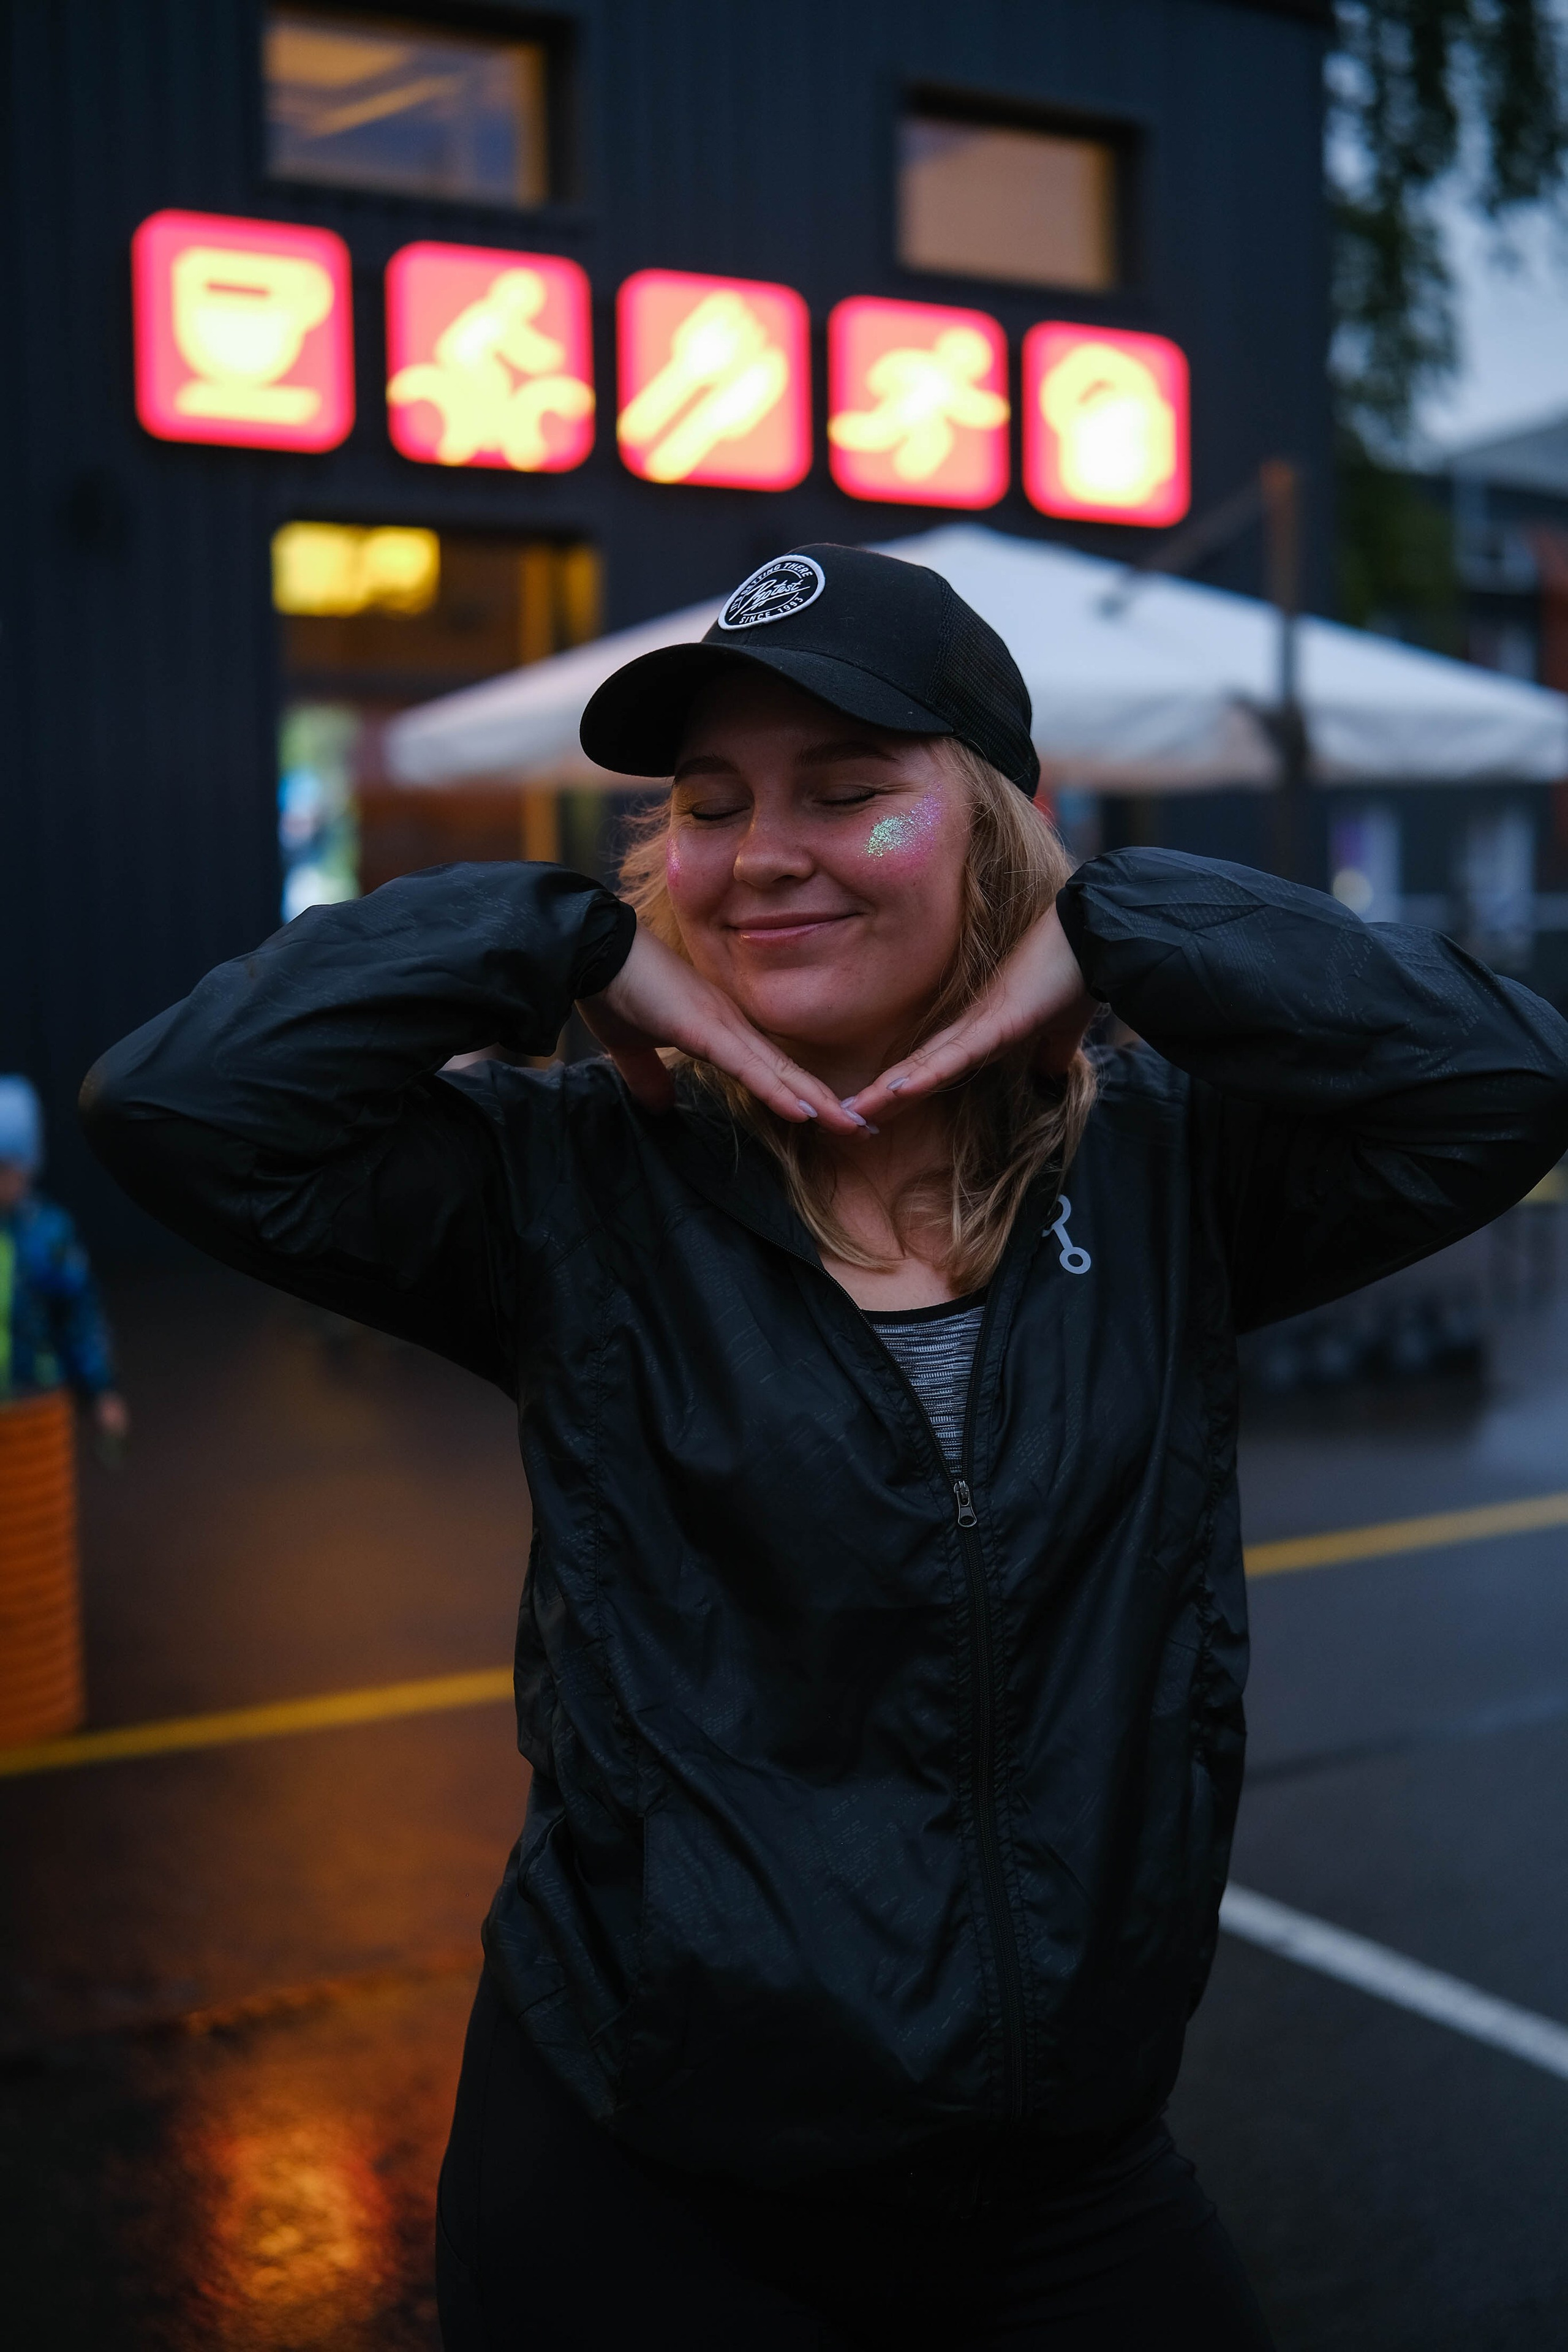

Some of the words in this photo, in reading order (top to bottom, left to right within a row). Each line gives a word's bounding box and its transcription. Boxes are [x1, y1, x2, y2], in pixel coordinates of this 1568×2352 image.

[741, 564, 781, 595] GETTING
[783, 562, 813, 577] THERE
[729, 579, 810, 620] Protest
[739, 611, 770, 624] SINCE
[777, 597, 803, 612] 1993
